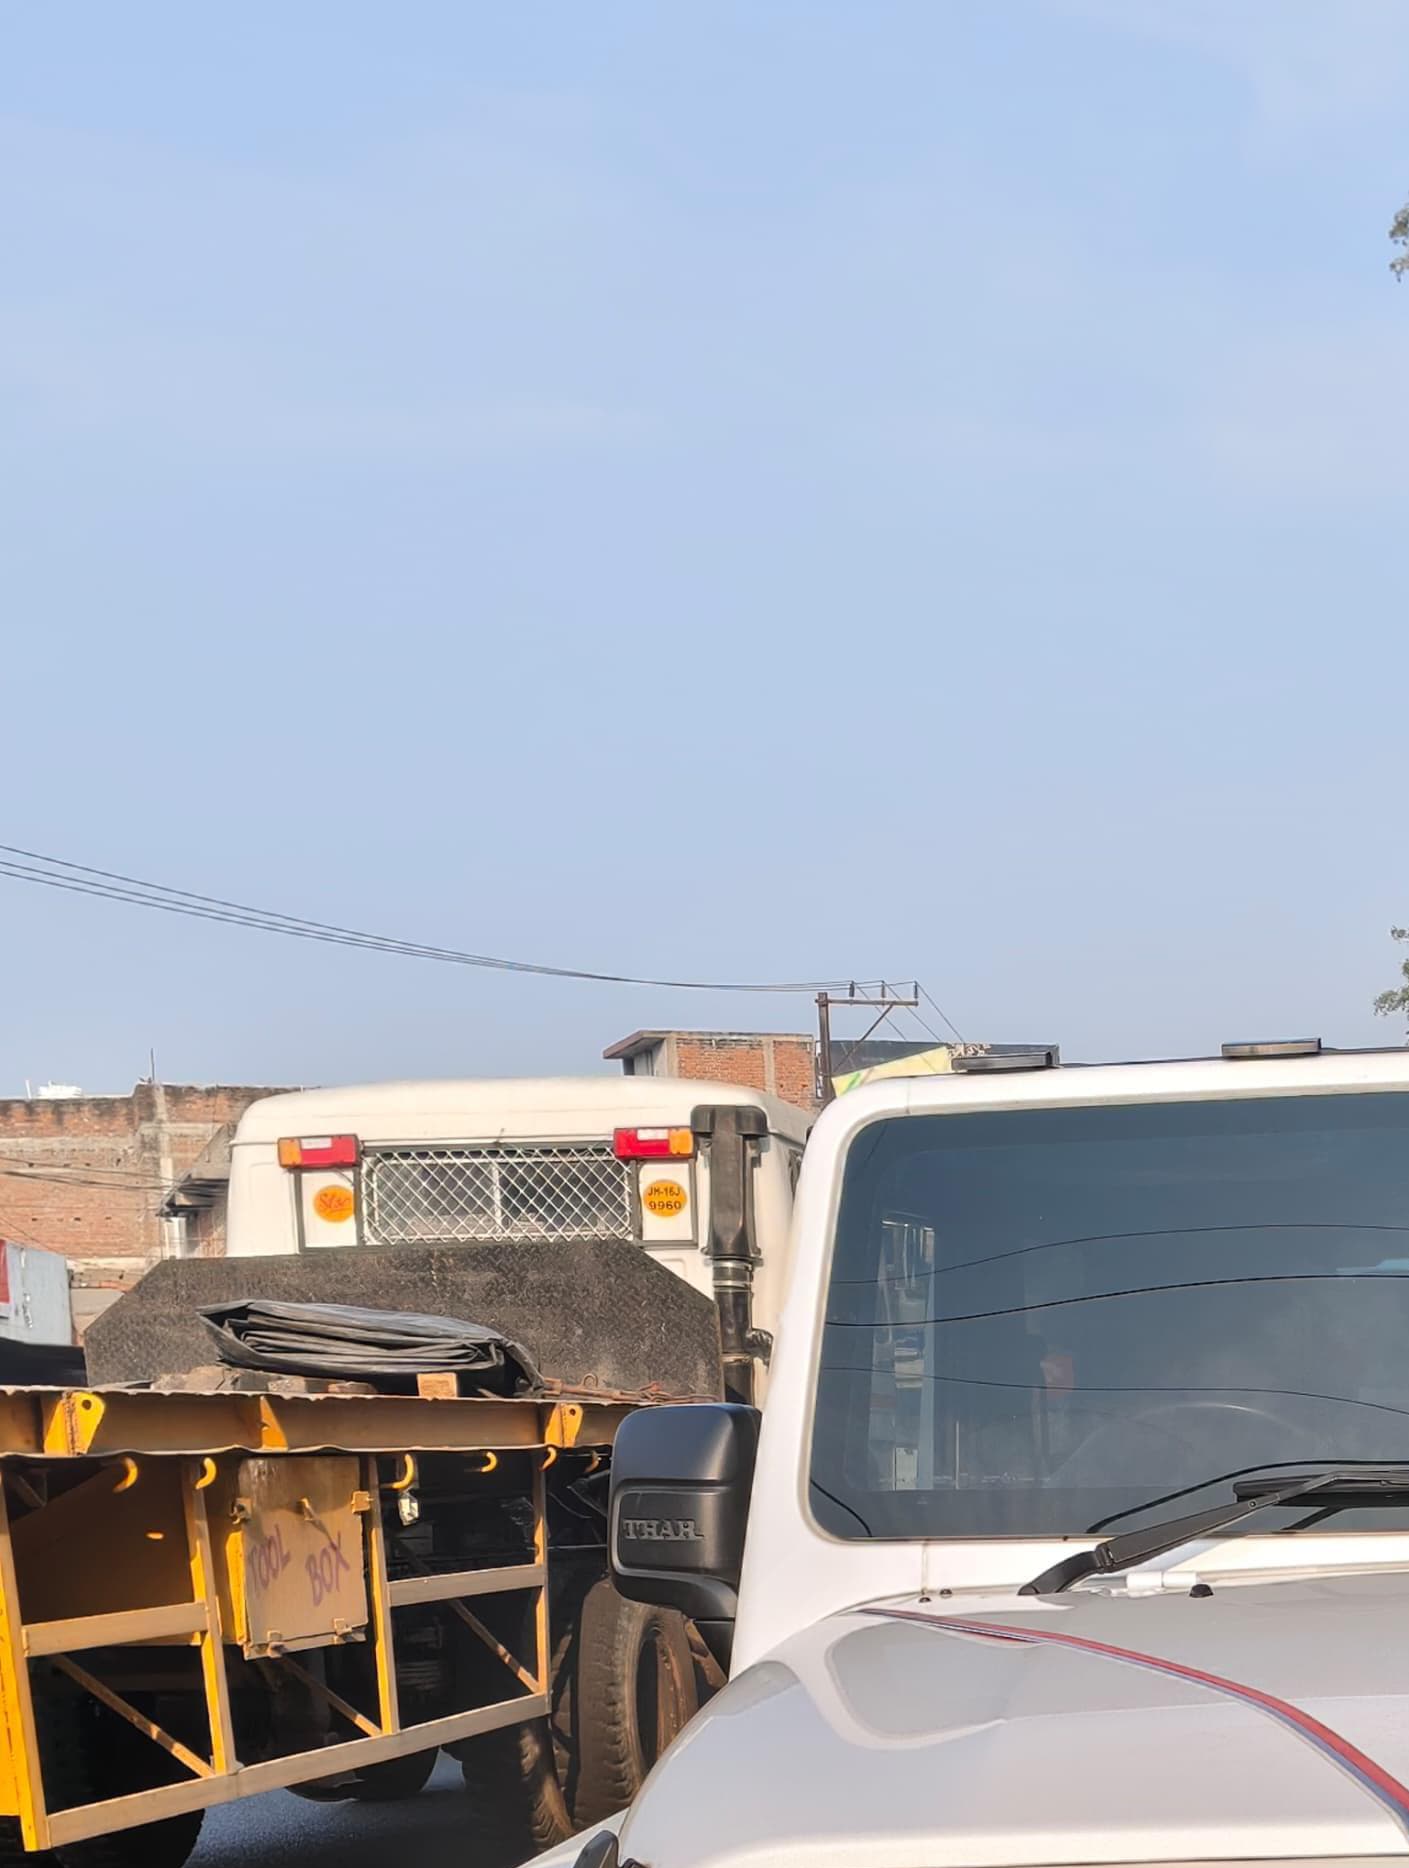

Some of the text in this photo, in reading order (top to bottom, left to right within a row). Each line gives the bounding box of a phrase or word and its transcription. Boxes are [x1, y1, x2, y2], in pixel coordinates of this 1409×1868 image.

[648, 1200, 682, 1210] 9960
[623, 1517, 705, 1541] THAR
[304, 1529, 351, 1607] BOX
